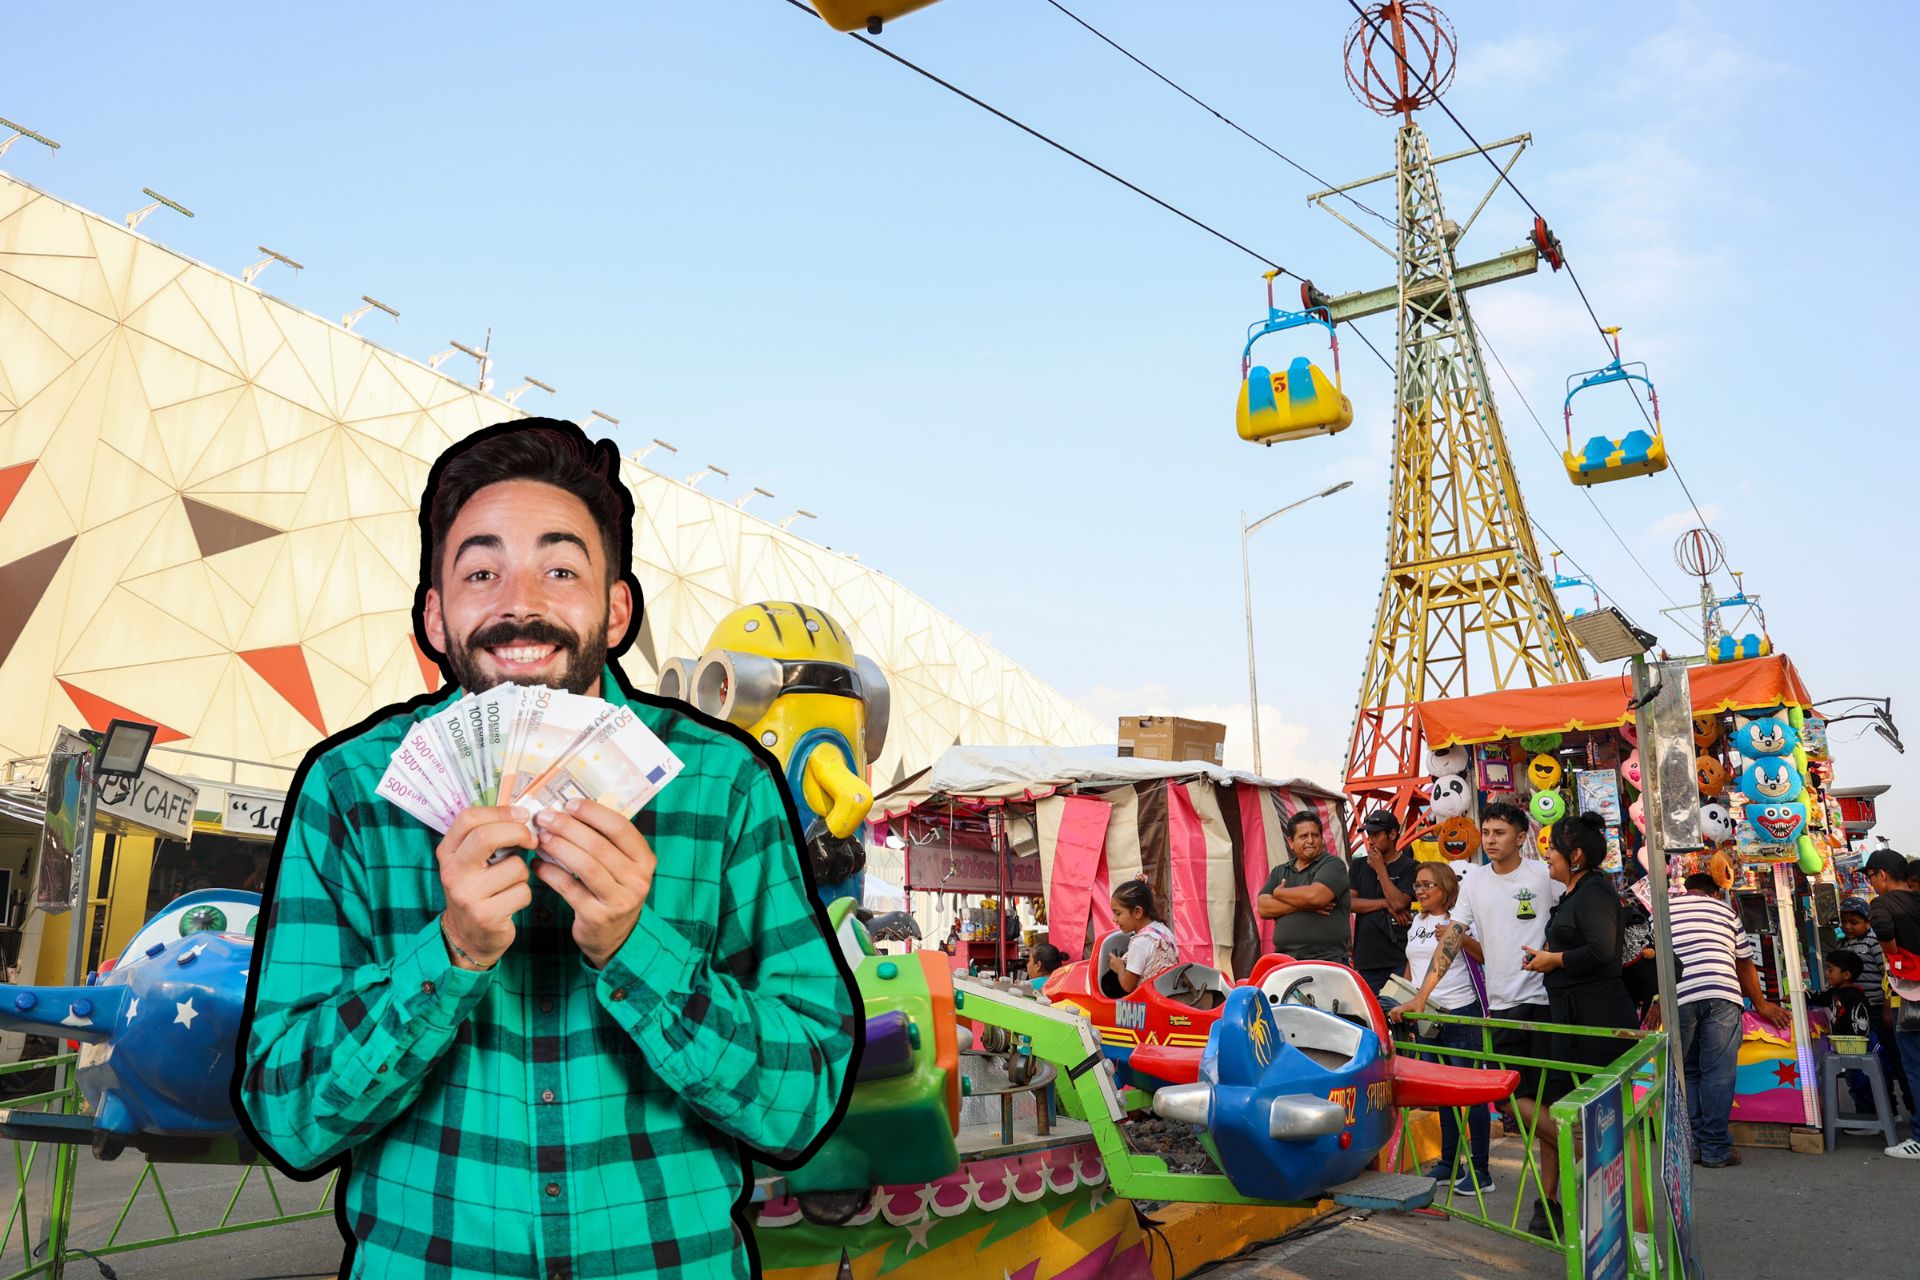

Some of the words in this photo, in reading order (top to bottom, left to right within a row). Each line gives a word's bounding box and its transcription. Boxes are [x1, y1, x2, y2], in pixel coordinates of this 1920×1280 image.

[535, 690, 551, 709] 50
[468, 705, 483, 727] 100
[487, 701, 500, 723] 100
[614, 709, 633, 728] 50
[447, 716, 464, 738] 100
[459, 736, 471, 757] EURO
[399, 749, 419, 771] 500
[411, 735, 432, 757] 500
[428, 753, 445, 774] EURO
[385, 776, 408, 797] 500
[406, 790, 428, 806] EURO
[144, 785, 193, 826] CAFÉ
